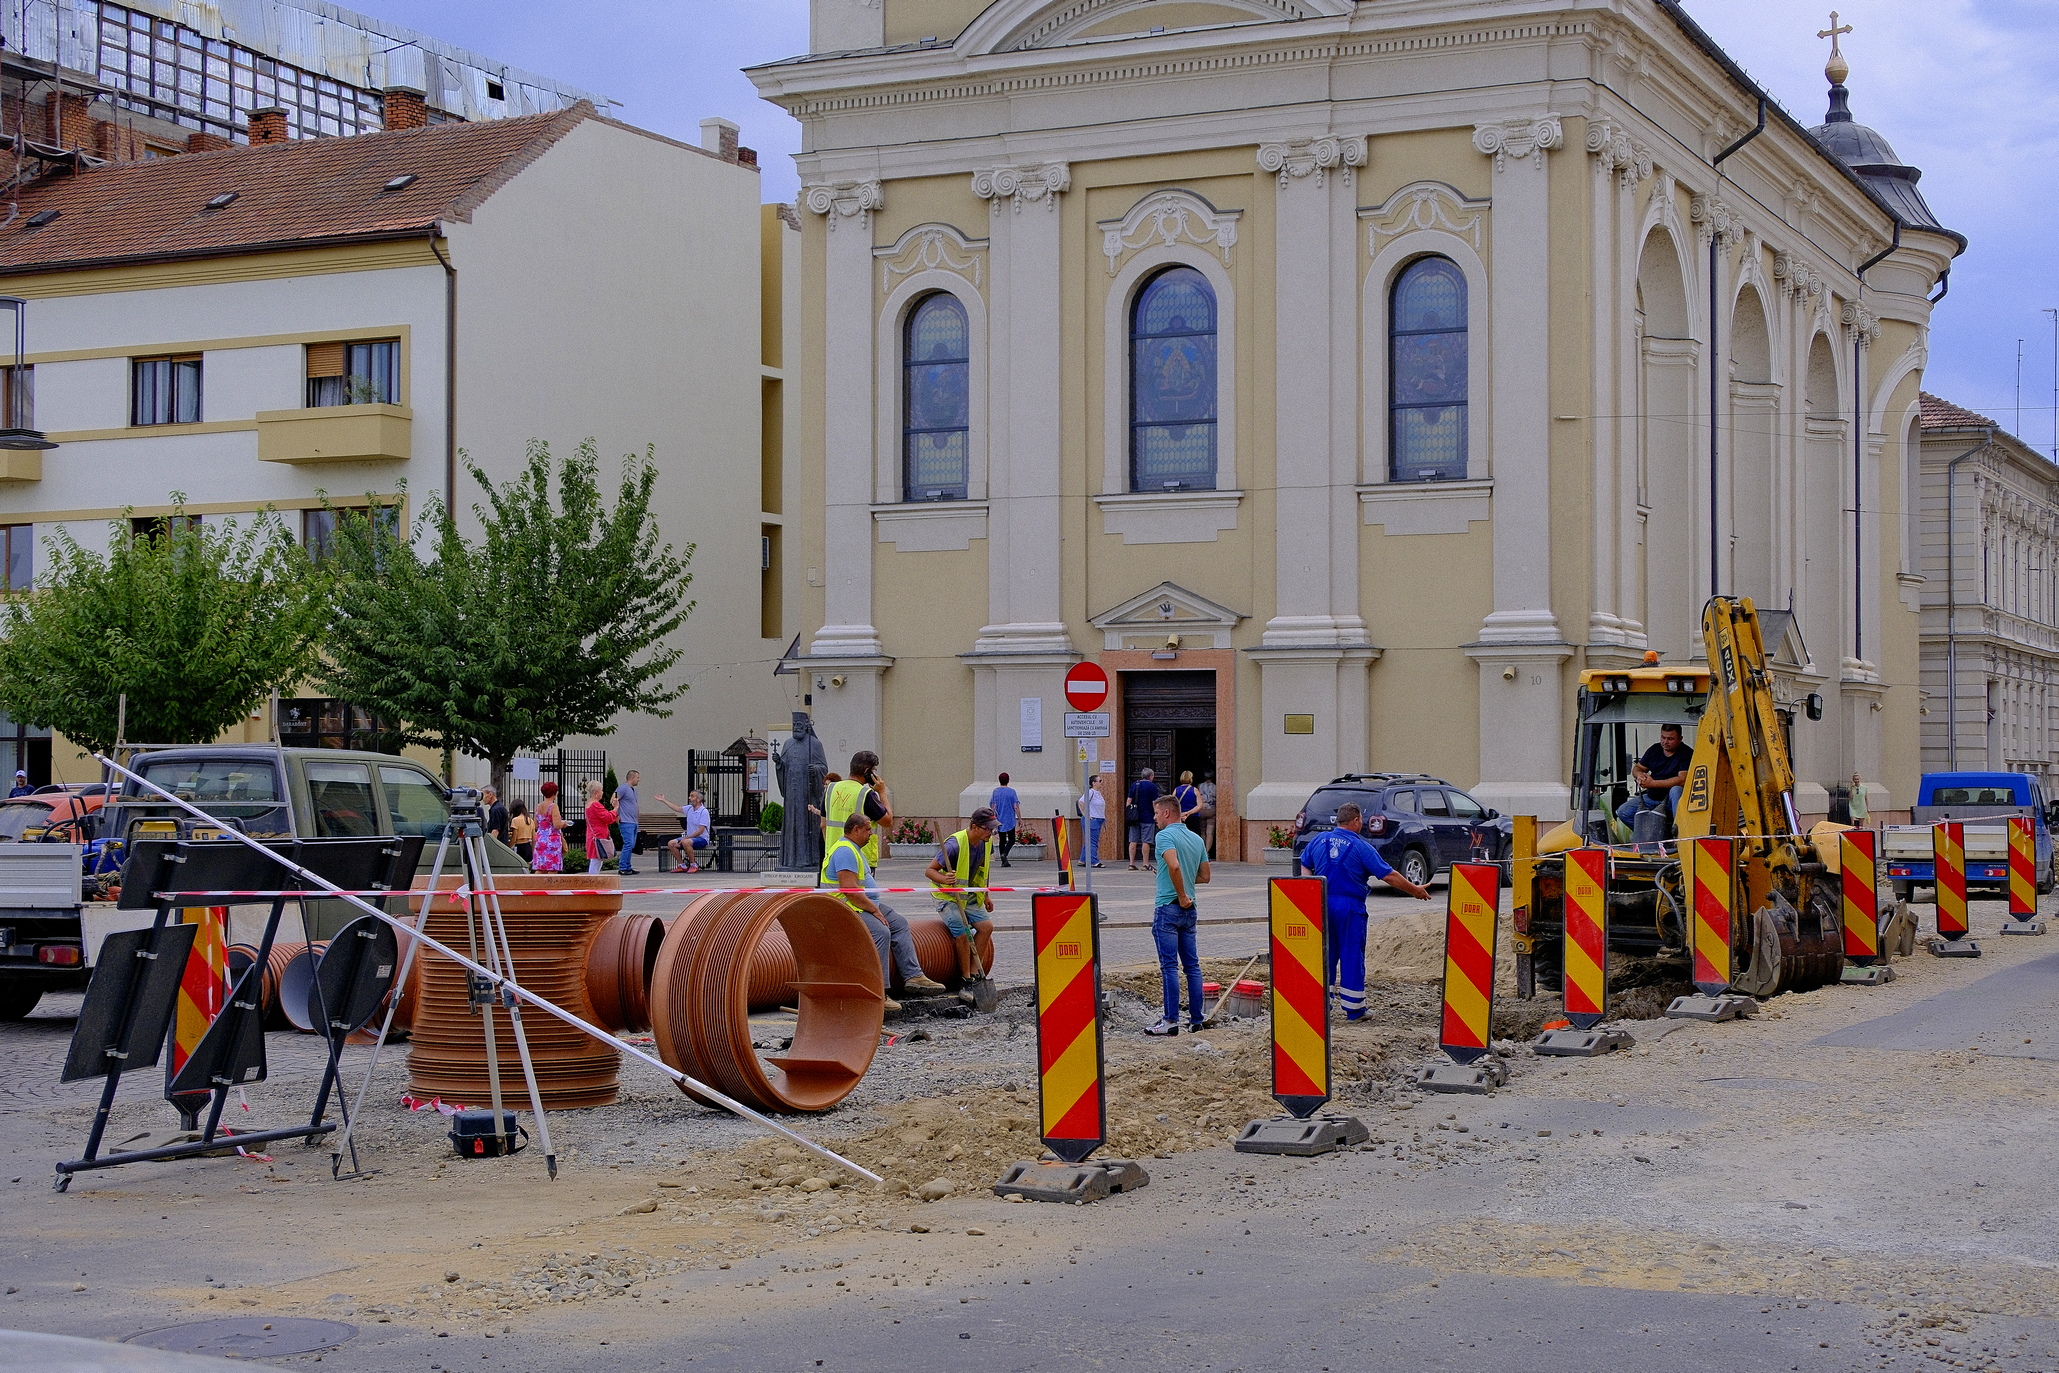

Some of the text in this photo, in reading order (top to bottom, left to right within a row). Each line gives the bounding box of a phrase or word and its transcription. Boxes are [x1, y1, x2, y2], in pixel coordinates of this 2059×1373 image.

[1724, 649, 1736, 683] 4CX
[1530, 675, 1542, 686] 10
[1690, 768, 1706, 807] JCB
[1288, 926, 1306, 937] PORR
[1058, 944, 1078, 956] PORR
